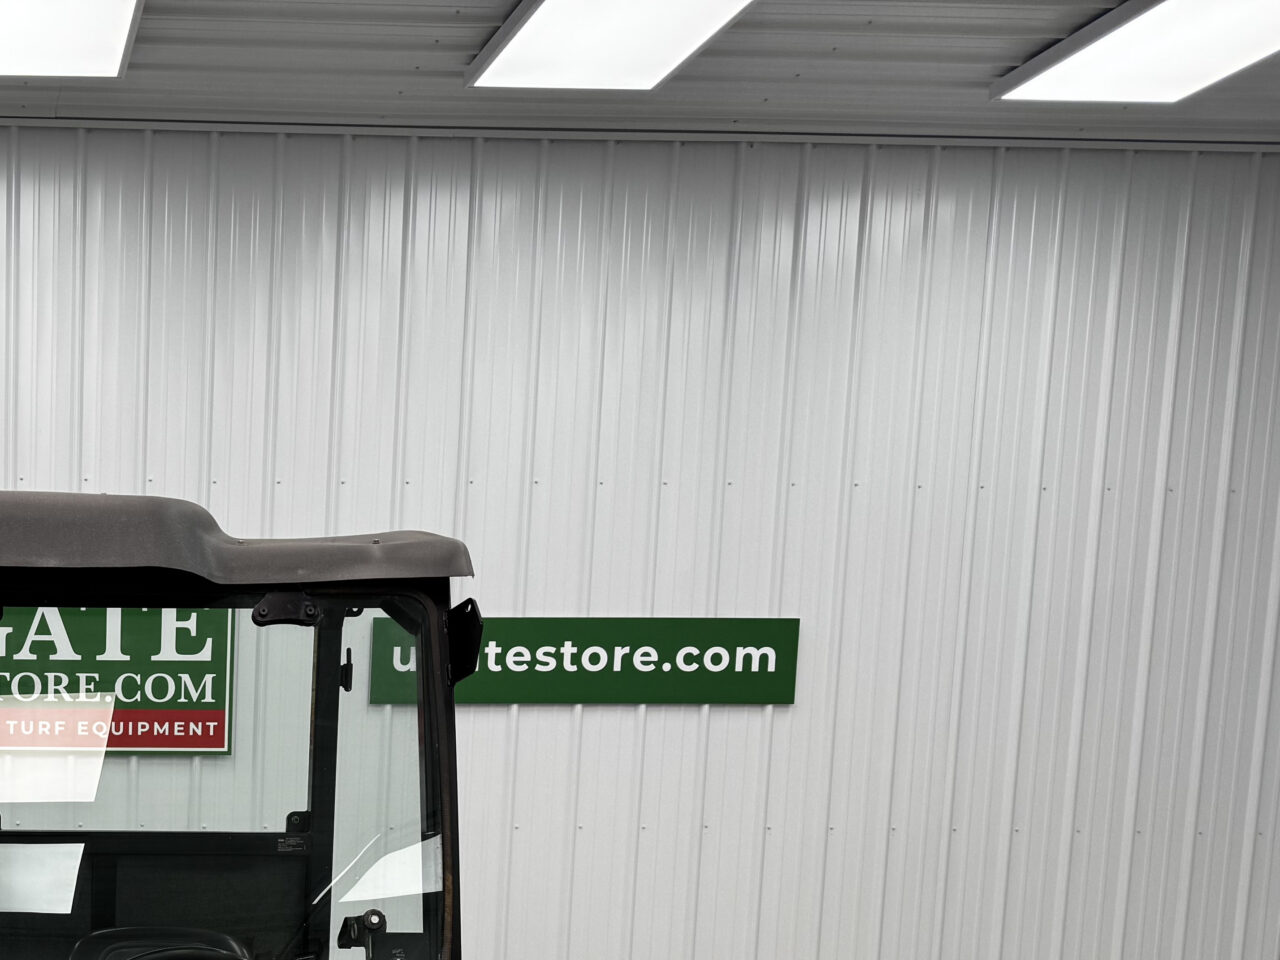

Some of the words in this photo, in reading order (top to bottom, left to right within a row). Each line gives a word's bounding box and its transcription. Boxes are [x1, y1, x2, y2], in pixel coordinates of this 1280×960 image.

[392, 640, 777, 672] utestore.com
[6, 720, 66, 736] TURF
[77, 721, 219, 738] EQUIPMENT
